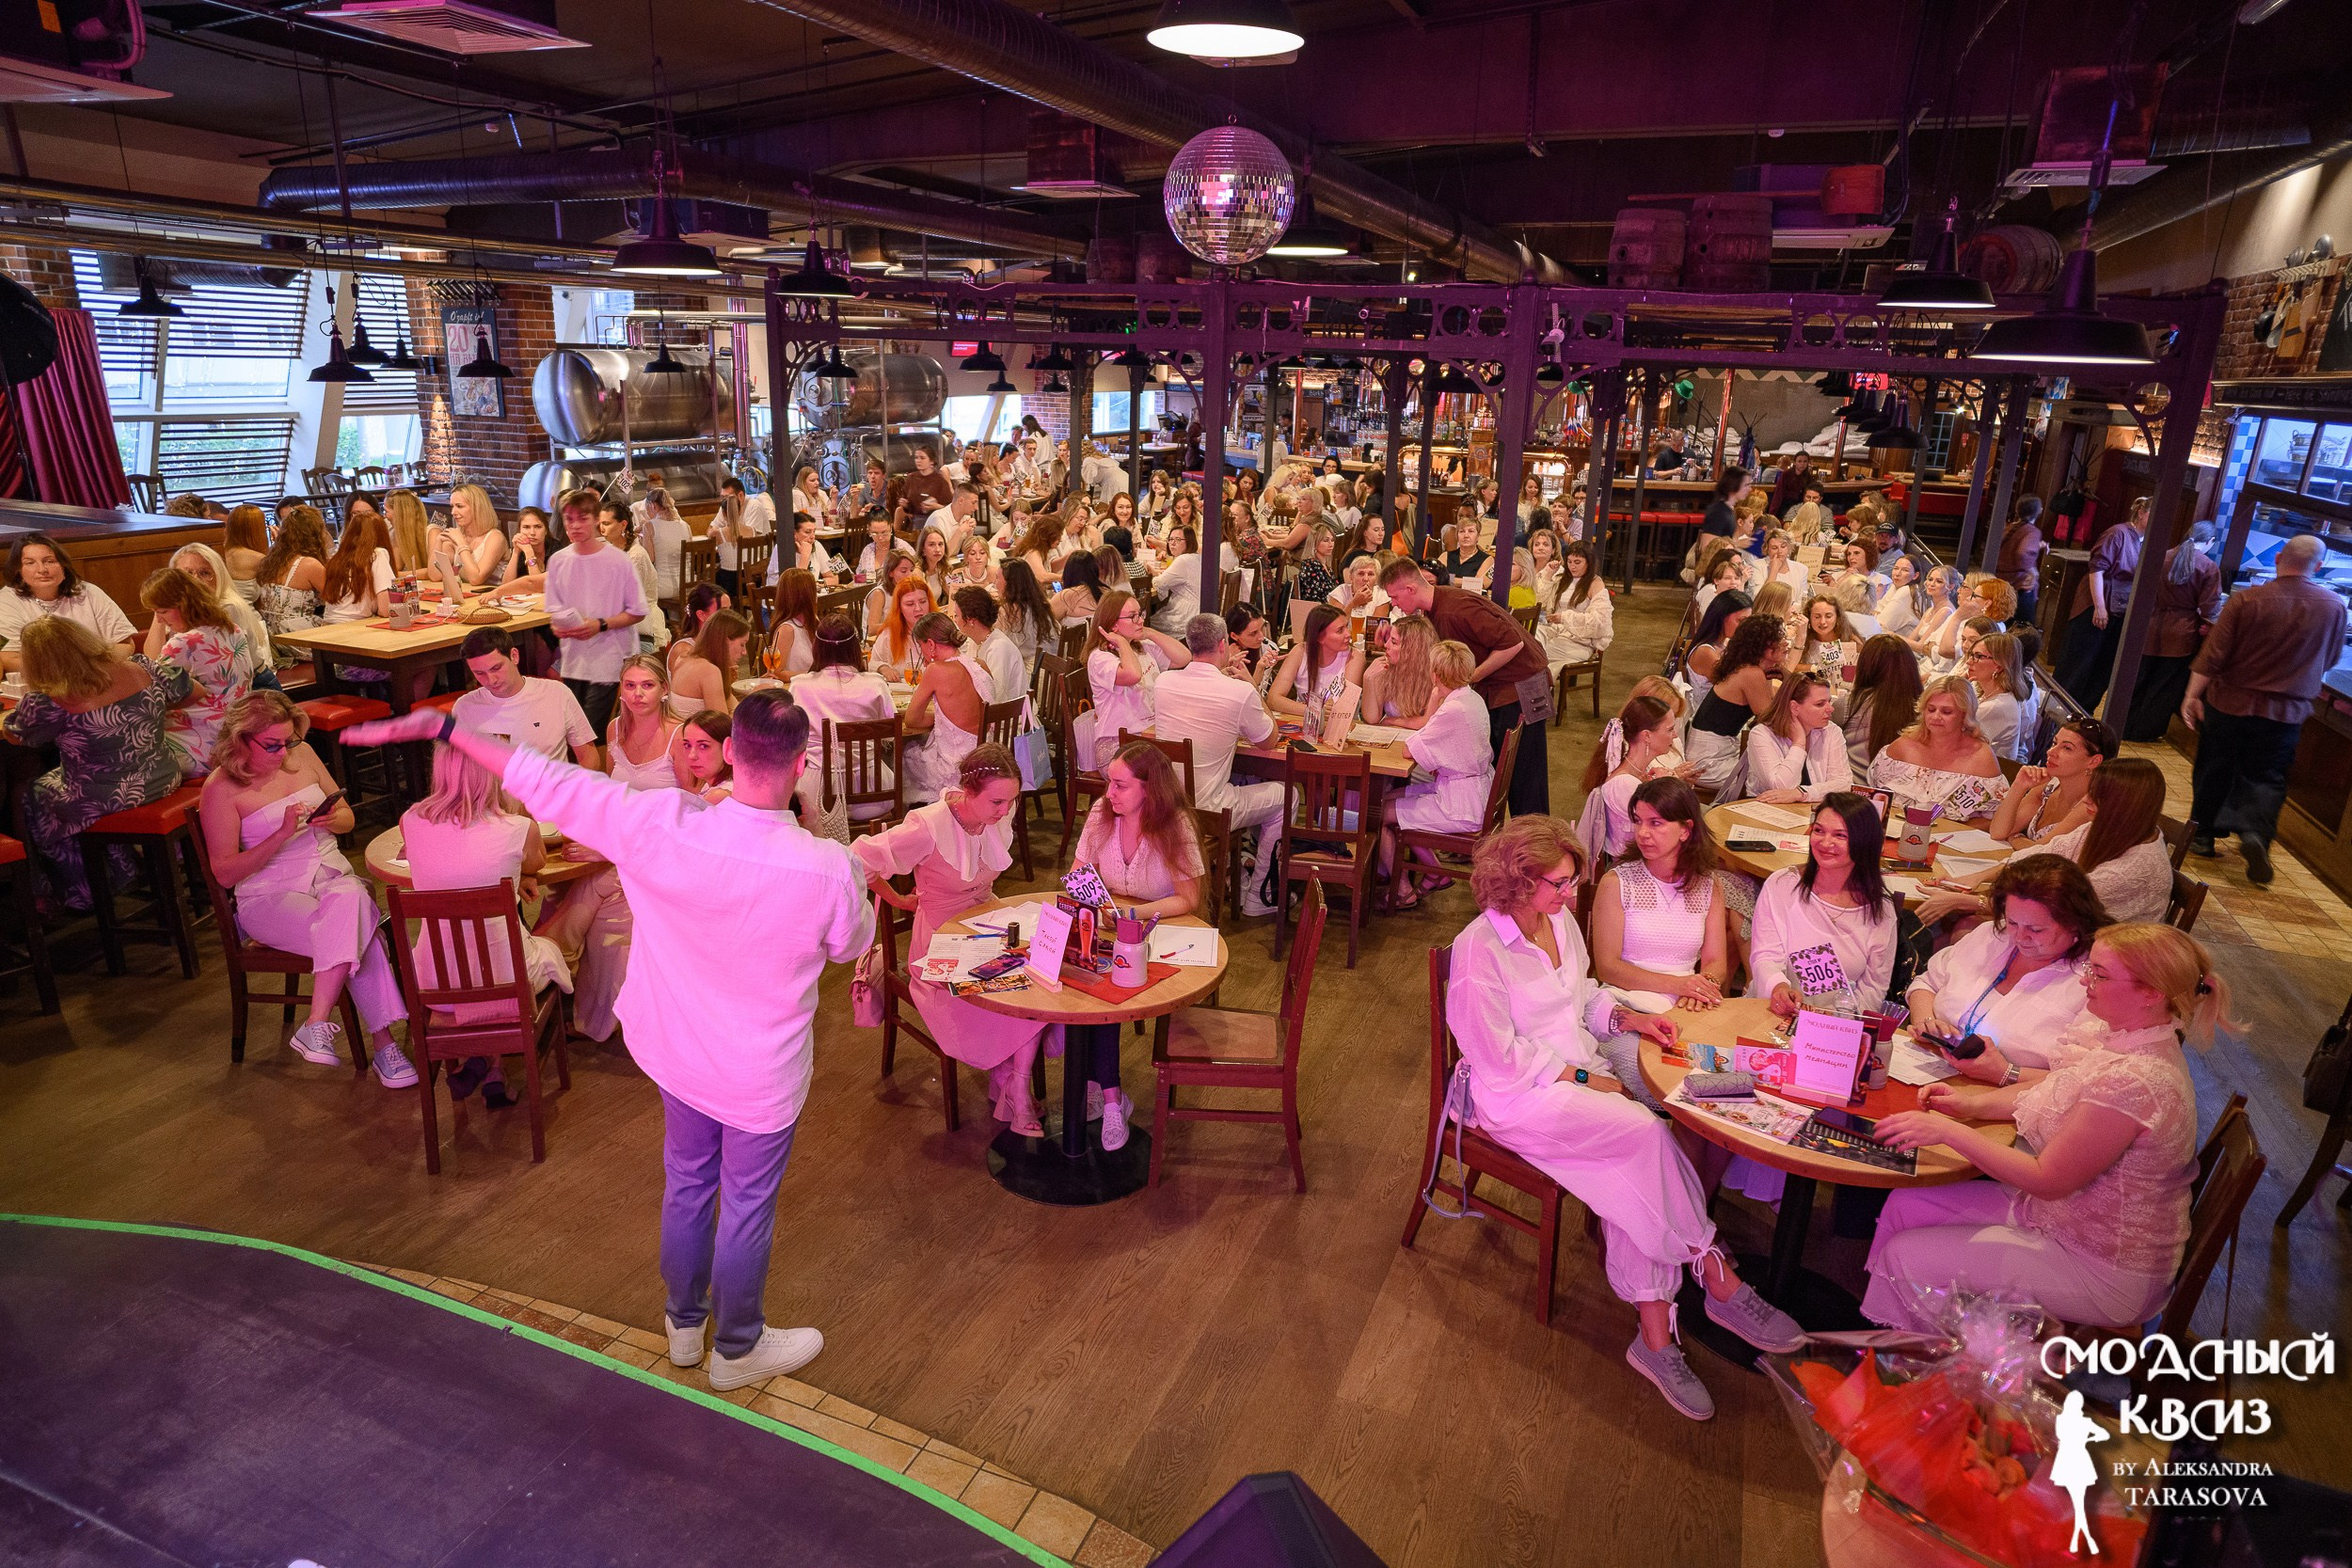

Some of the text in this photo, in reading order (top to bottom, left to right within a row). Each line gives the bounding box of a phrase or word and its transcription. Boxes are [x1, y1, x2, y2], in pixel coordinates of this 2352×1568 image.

[448, 325, 469, 353] 20
[1826, 651, 1839, 661] 403
[1956, 790, 1975, 809] 510
[1074, 880, 1097, 901] 509
[1805, 962, 1834, 983] 506
